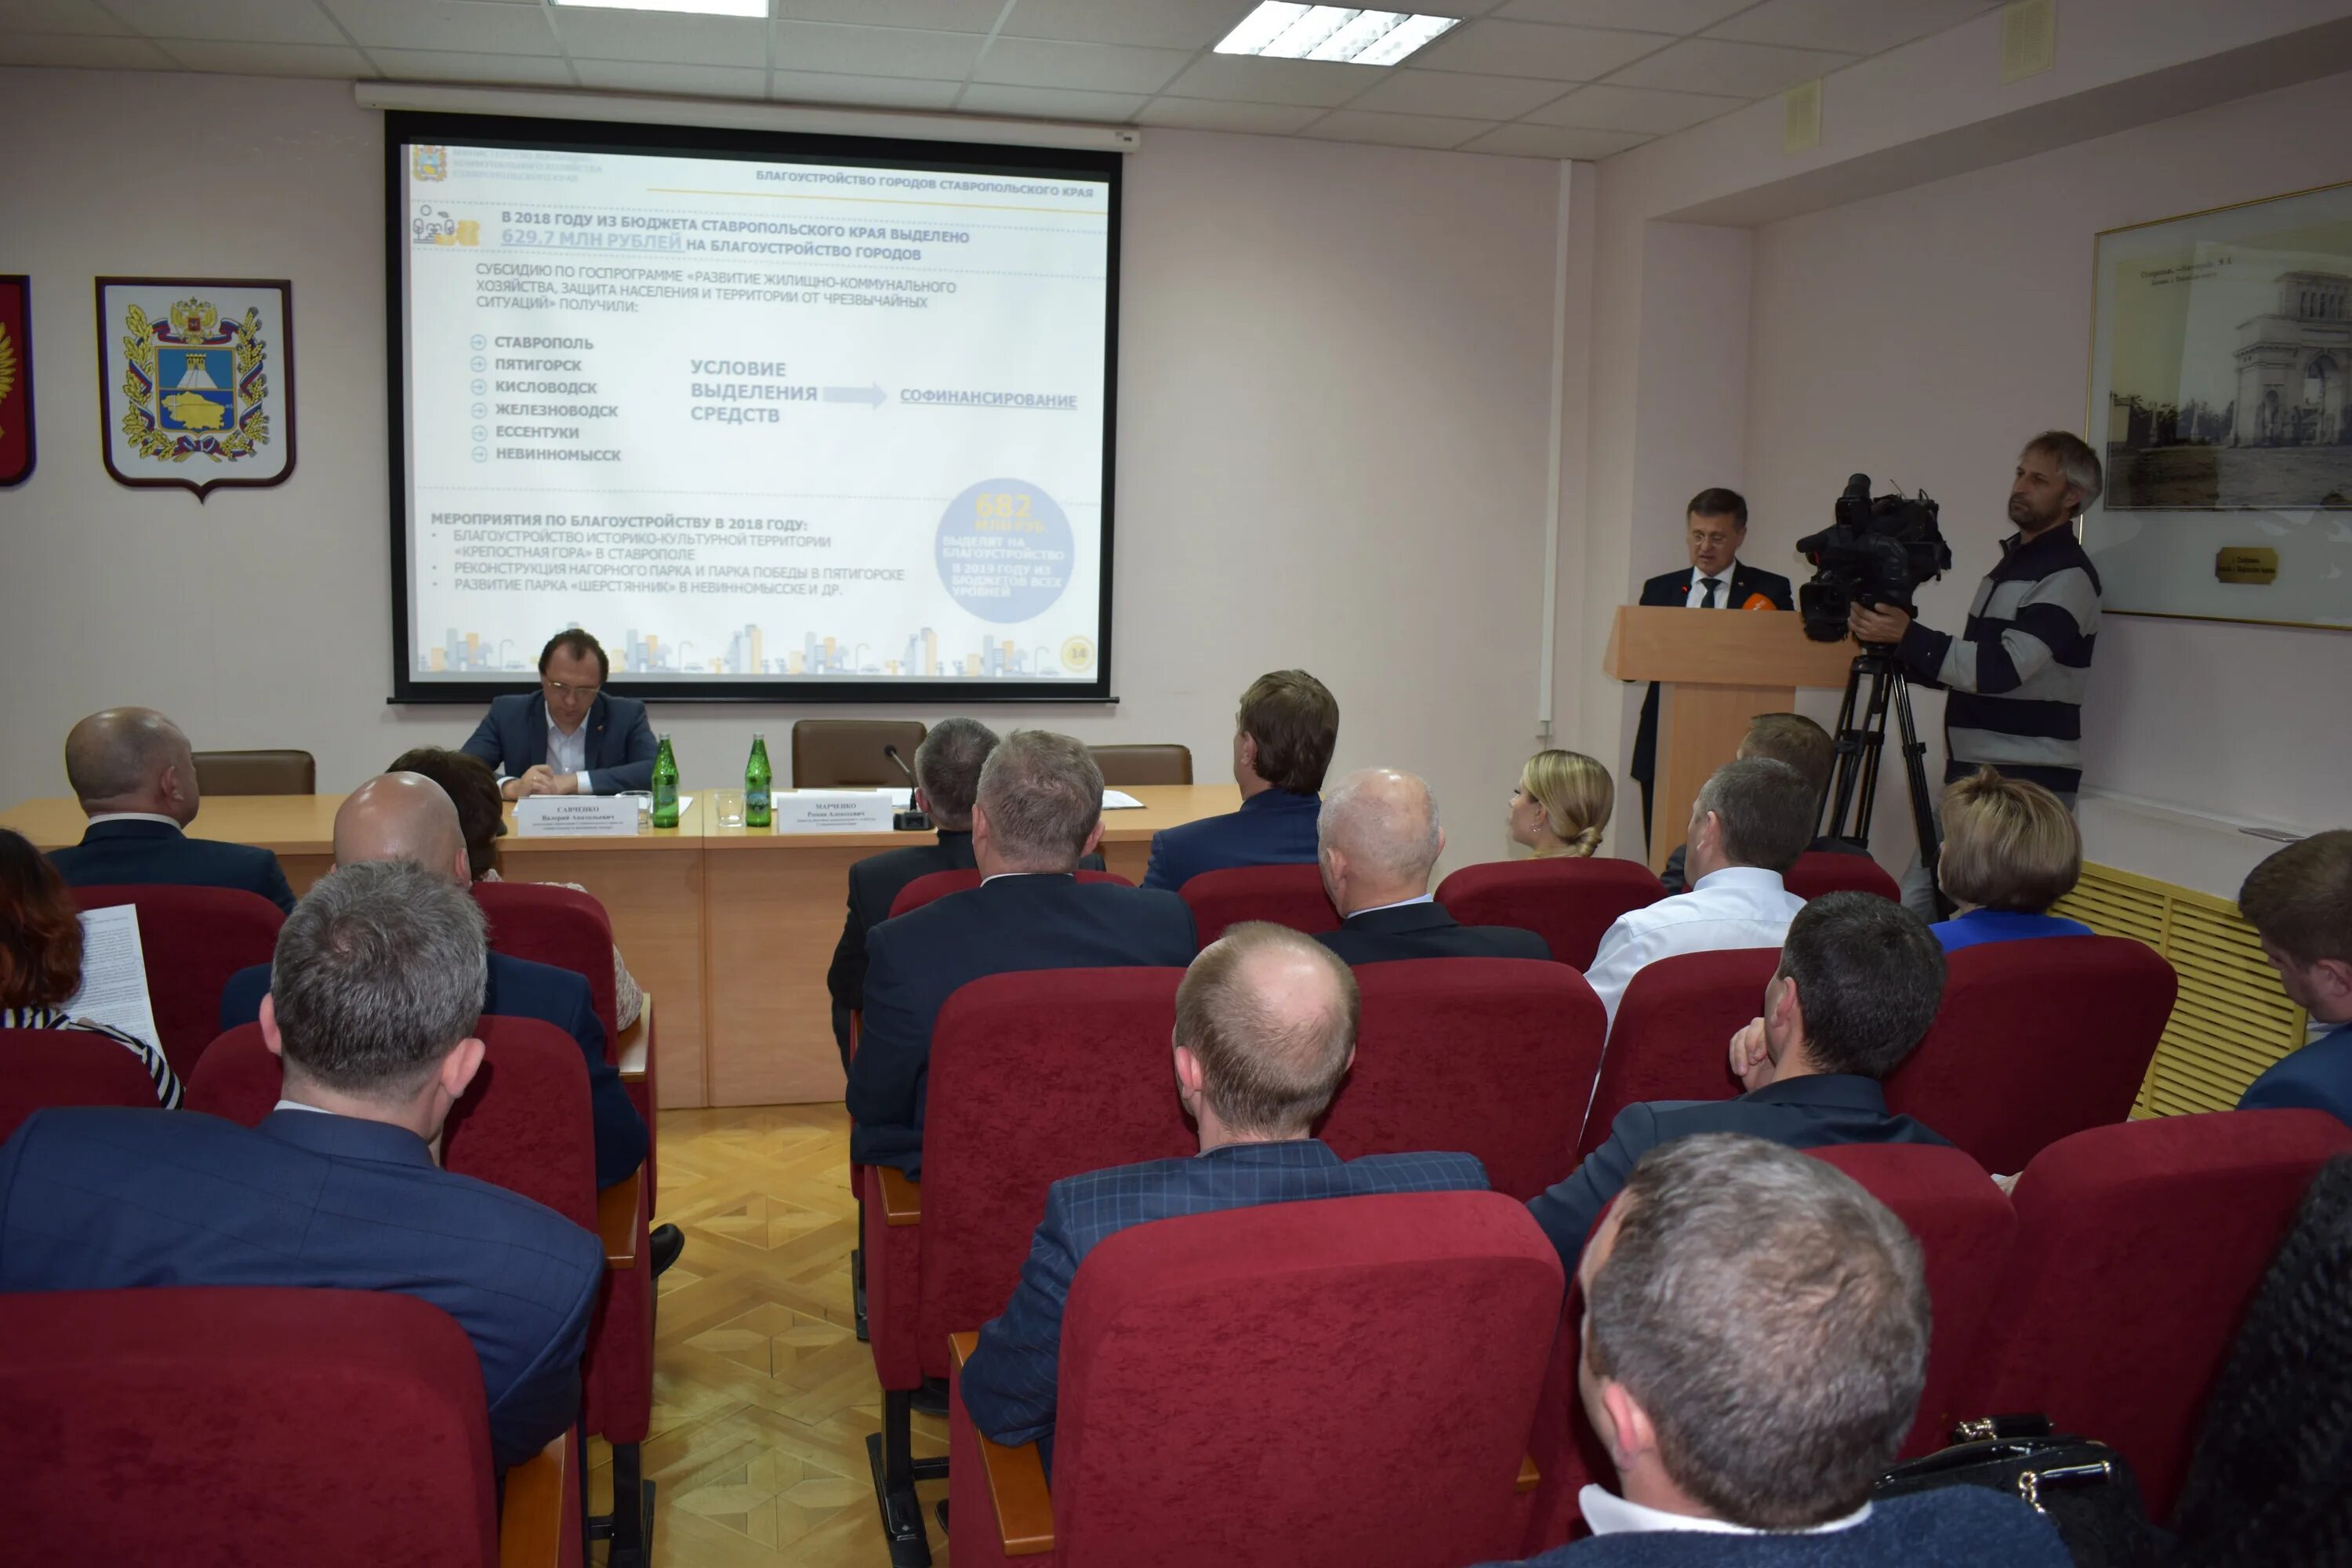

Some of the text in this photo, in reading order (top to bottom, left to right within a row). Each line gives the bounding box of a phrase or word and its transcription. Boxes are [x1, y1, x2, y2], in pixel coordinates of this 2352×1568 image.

[756, 170, 1093, 198] БЛАГОУСТРОЙСТВО ГОРОДОВ СТАВРОПОЛЬСКОГО КРАЯ
[502, 212, 970, 244] В 2018 ГОДУ ИЗ БЮДЖЕТА СТАВРОПОЛЬСКОГО КРАЯ ВЫДЕЛЕНО
[502, 230, 921, 260] 629,7 МЛН РУБЛЕЙ НА БЛАГОУСТРОЙСТВО ГОРОДОВ
[476, 263, 956, 293] СУБСИДИЮ ПО ГОСПРОГРАММЕ «РАЗВИТИЕ ЖИЛИЩНО-КОММУНАЛЬНОГО
[476, 278, 928, 309] ХОЗЯЙСТВА, ЗАЩИТА НАСЕЛЕНИЯ И ТЕРРИТОРИИ ОТ ЧРЕЗВЫЧАЙНЫХ
[476, 295, 639, 313] СИТУАЦИЙ» ПОЛУЧИЛИ:
[495, 336, 594, 350] СТАВРОПОЛЬ
[495, 359, 582, 372] ПЯТИГОРСК
[690, 359, 787, 377] УСЛОВИЕ
[495, 381, 597, 395] КИСЛОВОДСК
[690, 383, 818, 402] ВЫДЕЛЕНИЯ
[900, 388, 1077, 409] СОФИНАНСИРОВАНИЕ
[495, 404, 619, 418] ЖЕЛЕЗНОВОДСК
[690, 406, 781, 424] СРЕДСТВ
[495, 426, 579, 439] ЕССЕНТУКИ
[496, 448, 621, 462] НЕВИННОМЫССК
[975, 492, 1032, 517] 682
[430, 513, 808, 533] МЕРОПРИЯТИЯ ПО БЛАГОУСТРОЙСТВУ В 2018 ГОДУ:
[975, 520, 1011, 532] МЛН
[453, 531, 831, 549] БЛАГОУСТРОЙСТВО ИСТОРИКО-КУЛЬТУРНОЙ ТЕРРИТОРИИ
[1007, 536, 1025, 546] НА
[454, 547, 695, 561] «КРЕПОСТНАЯ ГОРА» В СТАВРОПОЛЕ
[942, 546, 1065, 561] БЛАГОУСТРОЙСТВО
[454, 563, 904, 582] РЕКОНСТРУКЦИЯ НАГОРНОГО ПАРКА И ПАРКА ПОБЕДЫ В ПЯТИГОРСКЕ
[952, 564, 1051, 575] В 2019 ГОДУ ИЗ
[455, 579, 844, 597] РАЗВИТИЕ ПАРКА «ШЕРСТЯННИК» В НЕВИННОМЫССКЕ И ДР.
[952, 575, 1062, 588] БЮДЖЕТОВ ВСЕХ
[952, 584, 1011, 597] УРОВНЕЙ
